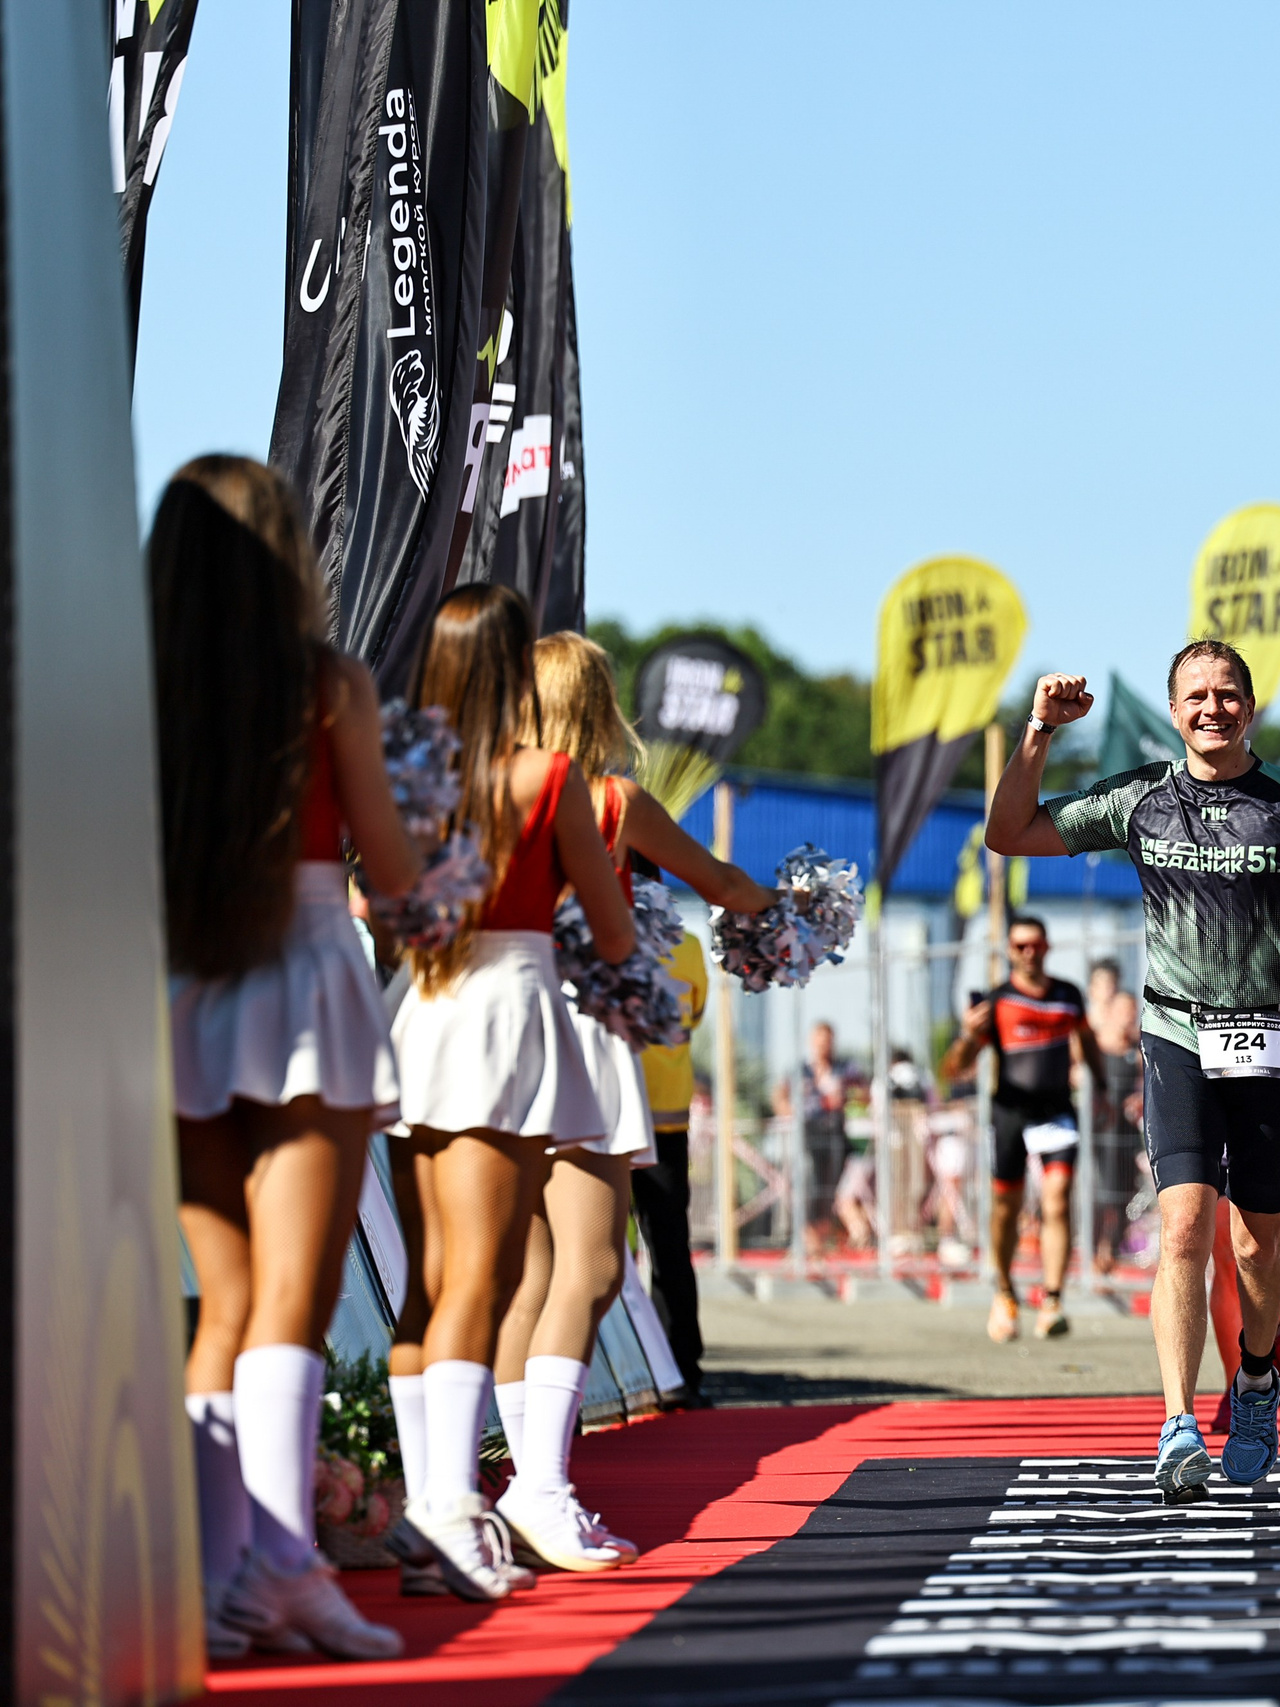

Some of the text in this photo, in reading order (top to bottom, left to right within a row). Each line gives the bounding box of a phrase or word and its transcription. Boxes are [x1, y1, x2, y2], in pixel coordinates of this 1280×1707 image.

[379, 88, 416, 338] Legenda
[910, 625, 997, 678] STAR
[1140, 837, 1245, 860] МЕДНЫЙ
[1141, 851, 1244, 874] ВСАДНИК
[1219, 1032, 1267, 1052] 724
[1235, 1055, 1253, 1064] 113
